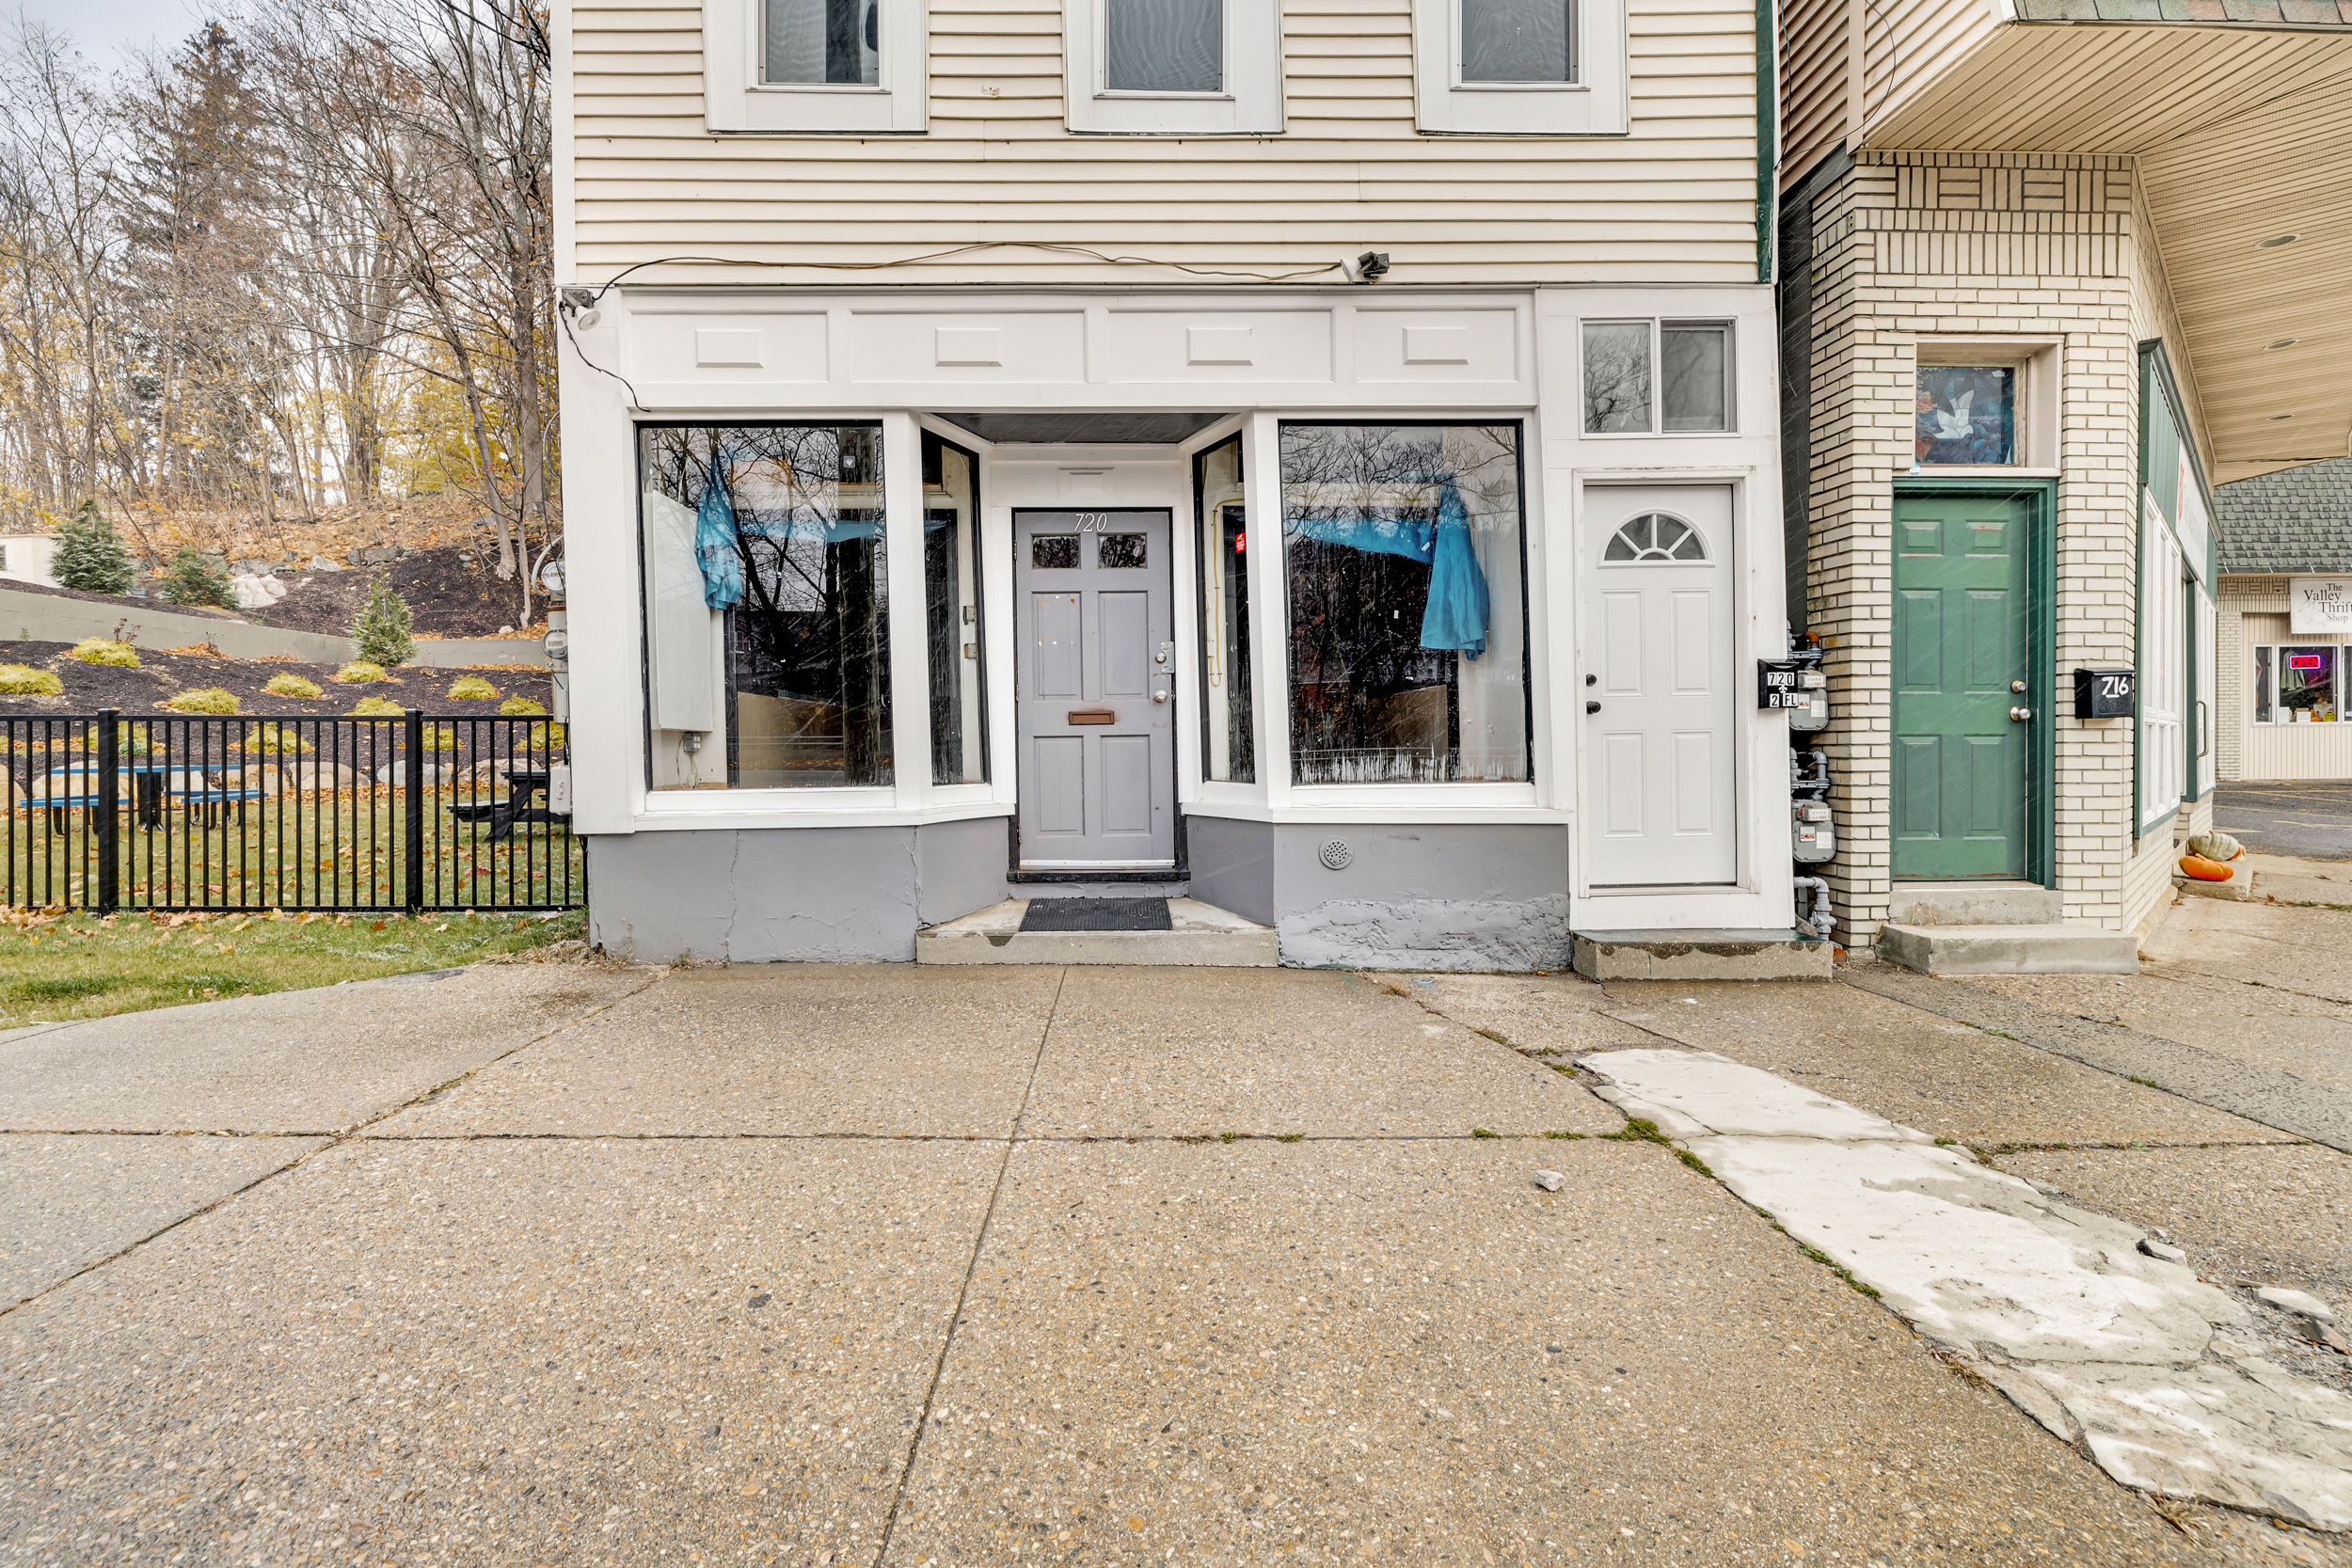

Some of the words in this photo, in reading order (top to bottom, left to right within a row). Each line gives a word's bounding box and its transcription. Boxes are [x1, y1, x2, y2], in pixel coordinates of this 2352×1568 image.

[1073, 513, 1107, 532] 720
[2304, 589, 2342, 603] Valley
[2327, 614, 2349, 623] Shop
[2292, 657, 2319, 667] OPEN
[1769, 673, 1793, 685] 720
[2101, 676, 2129, 695] 716
[1772, 695, 1778, 706] 2
[1785, 694, 1796, 705] FL
